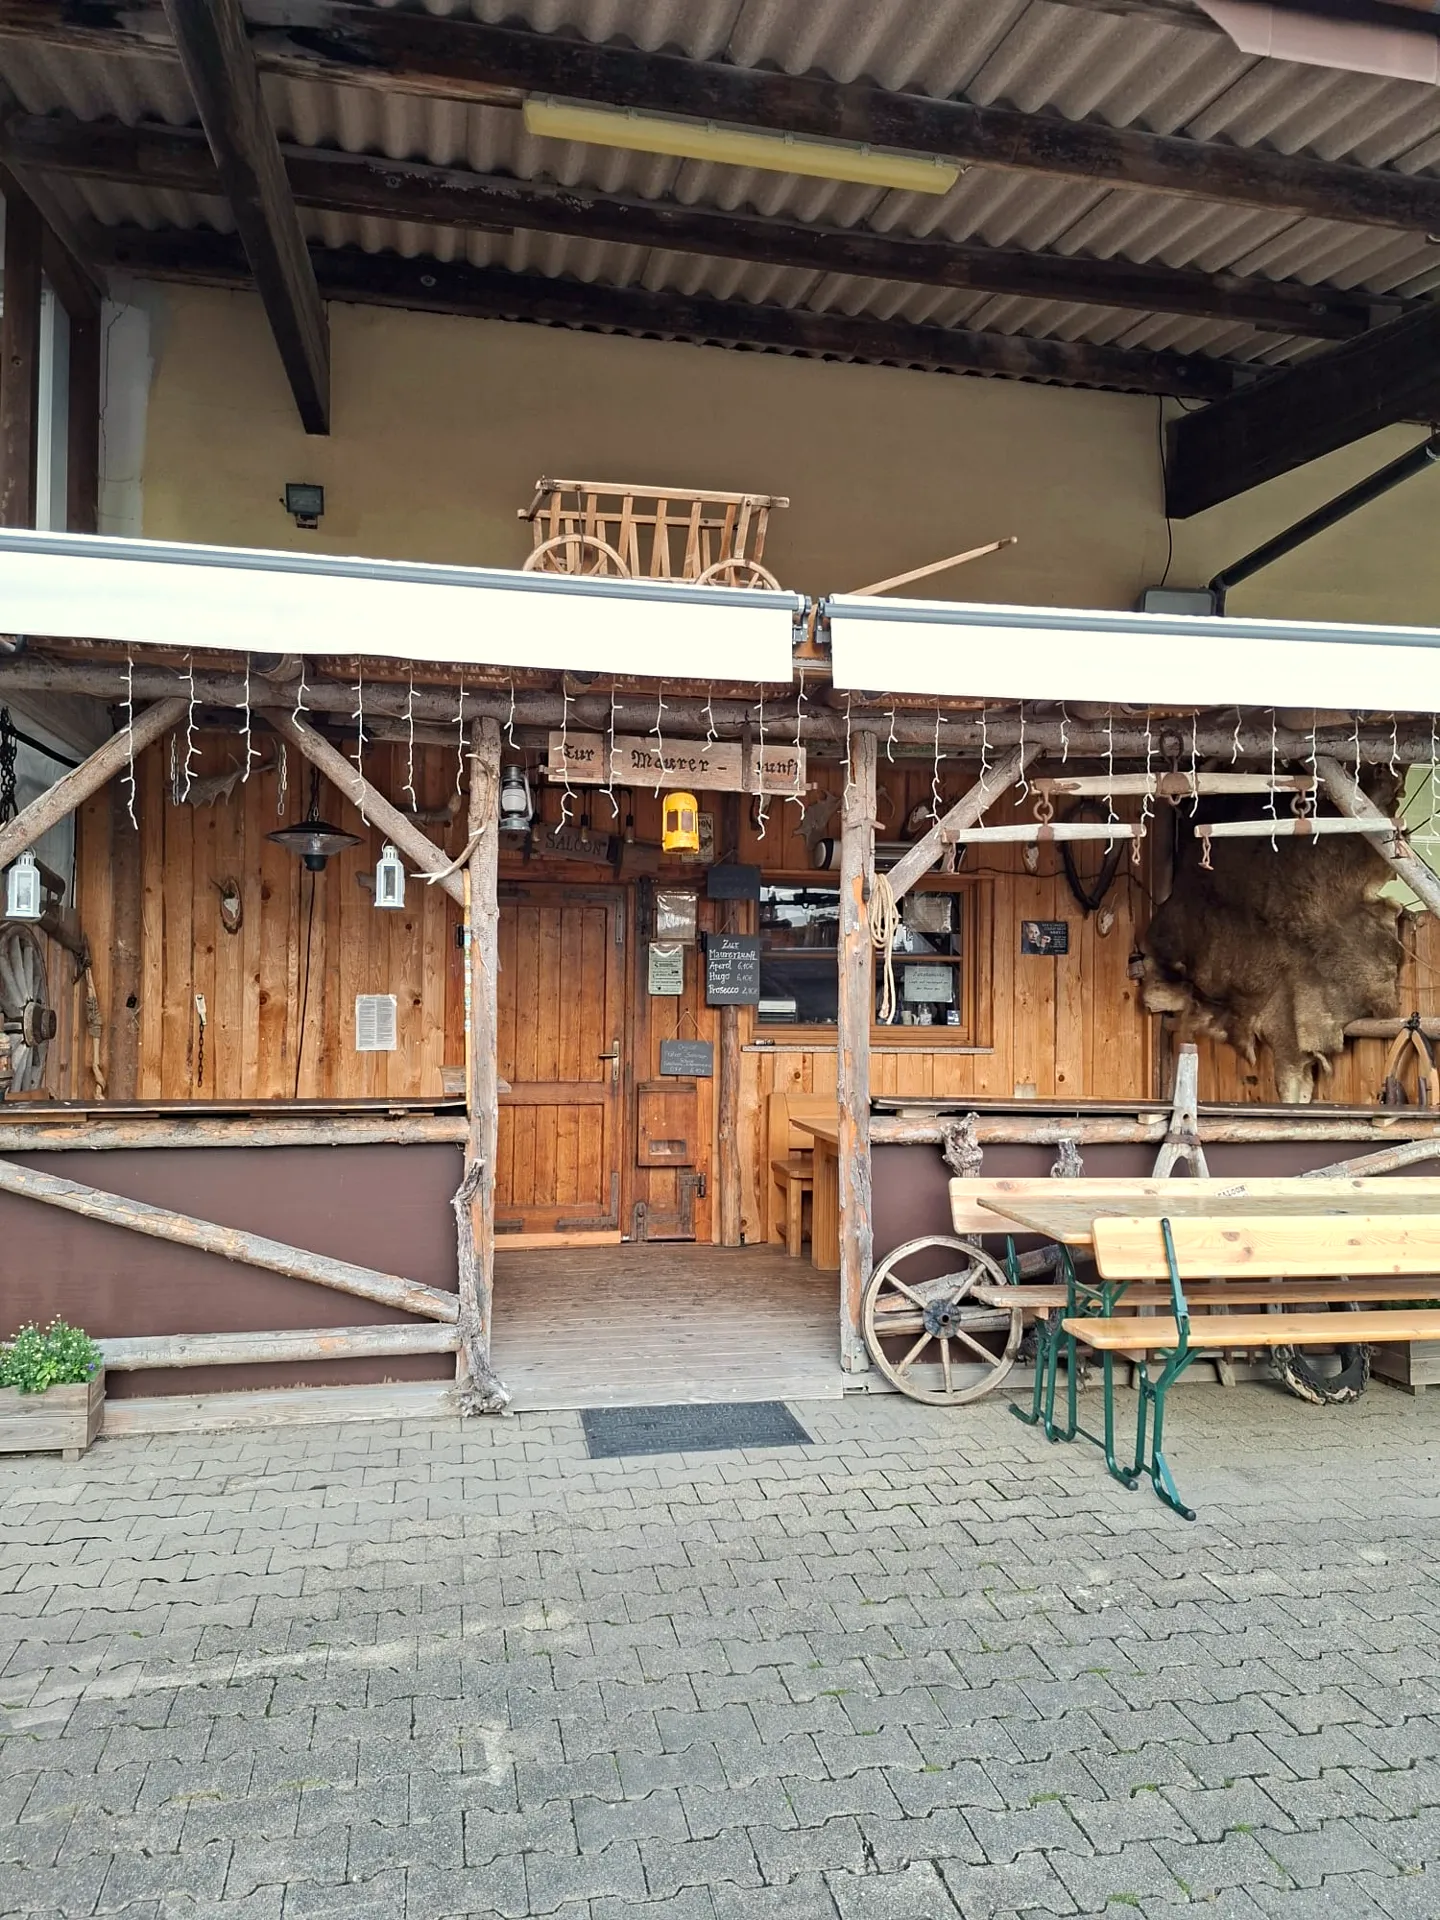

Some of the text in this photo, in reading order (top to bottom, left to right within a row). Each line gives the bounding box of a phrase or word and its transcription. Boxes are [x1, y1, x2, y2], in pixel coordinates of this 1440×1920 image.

[721, 939, 740, 949] Zur
[709, 949, 757, 960] Maurerzunft
[709, 960, 732, 972] Aperol
[709, 971, 730, 984] Hugo
[708, 984, 739, 994] Prosecco
